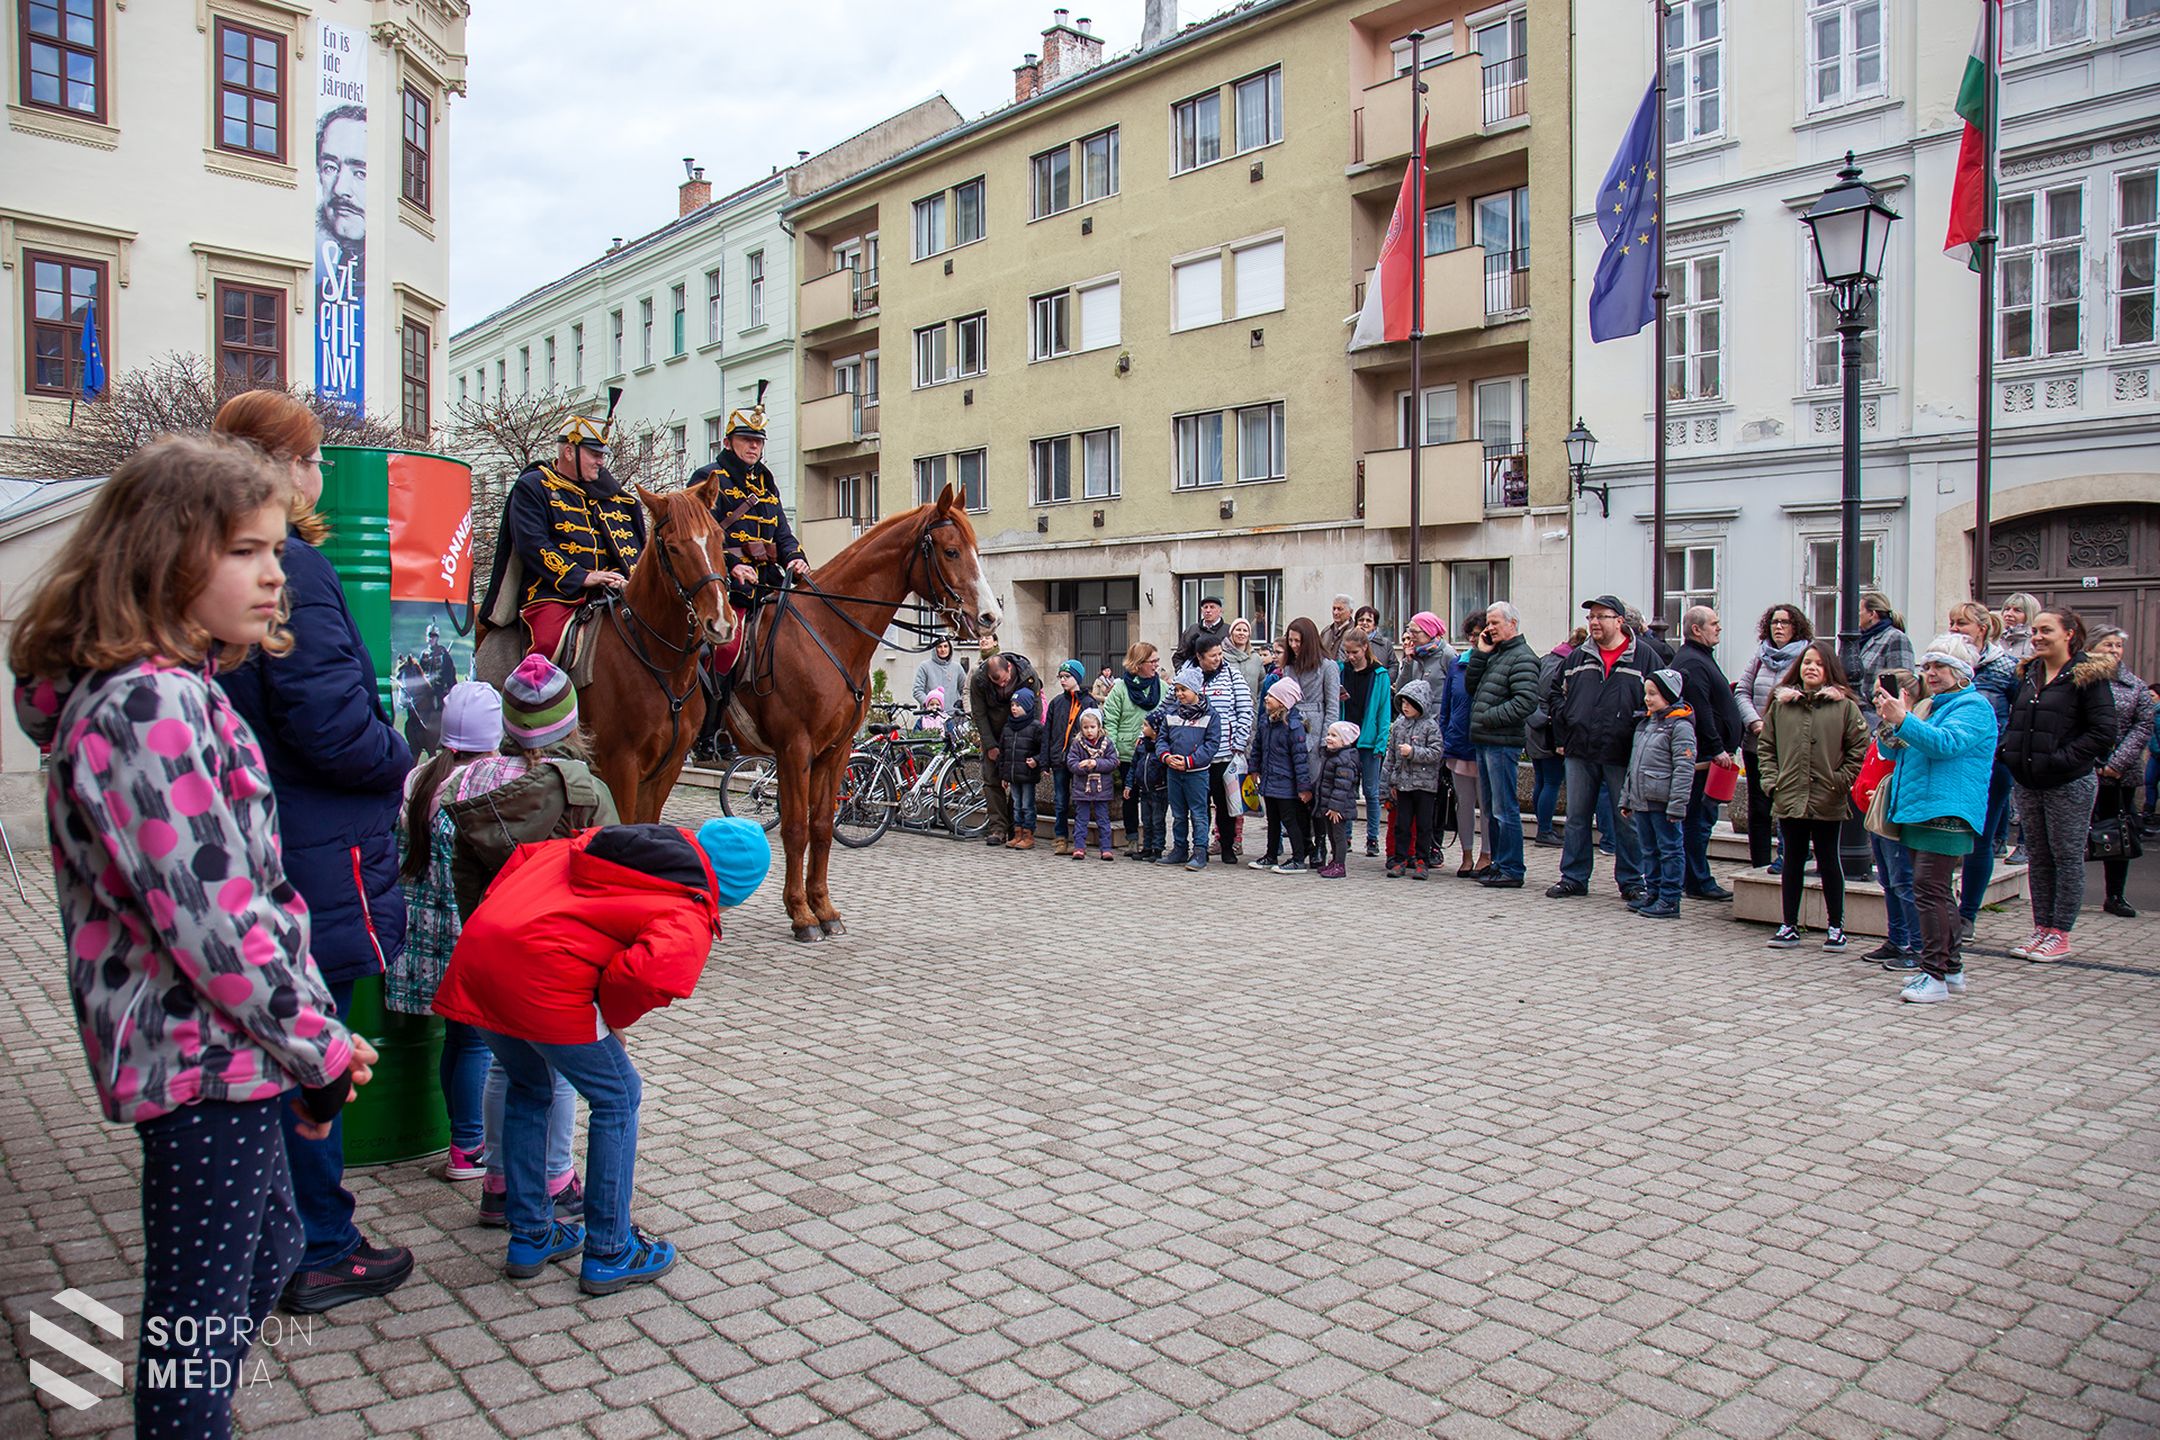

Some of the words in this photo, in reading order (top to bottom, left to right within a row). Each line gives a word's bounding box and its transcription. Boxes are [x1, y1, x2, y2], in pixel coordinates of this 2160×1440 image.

[323, 25, 337, 49] Én
[340, 32, 350, 53] is
[320, 74, 364, 103] járnék!
